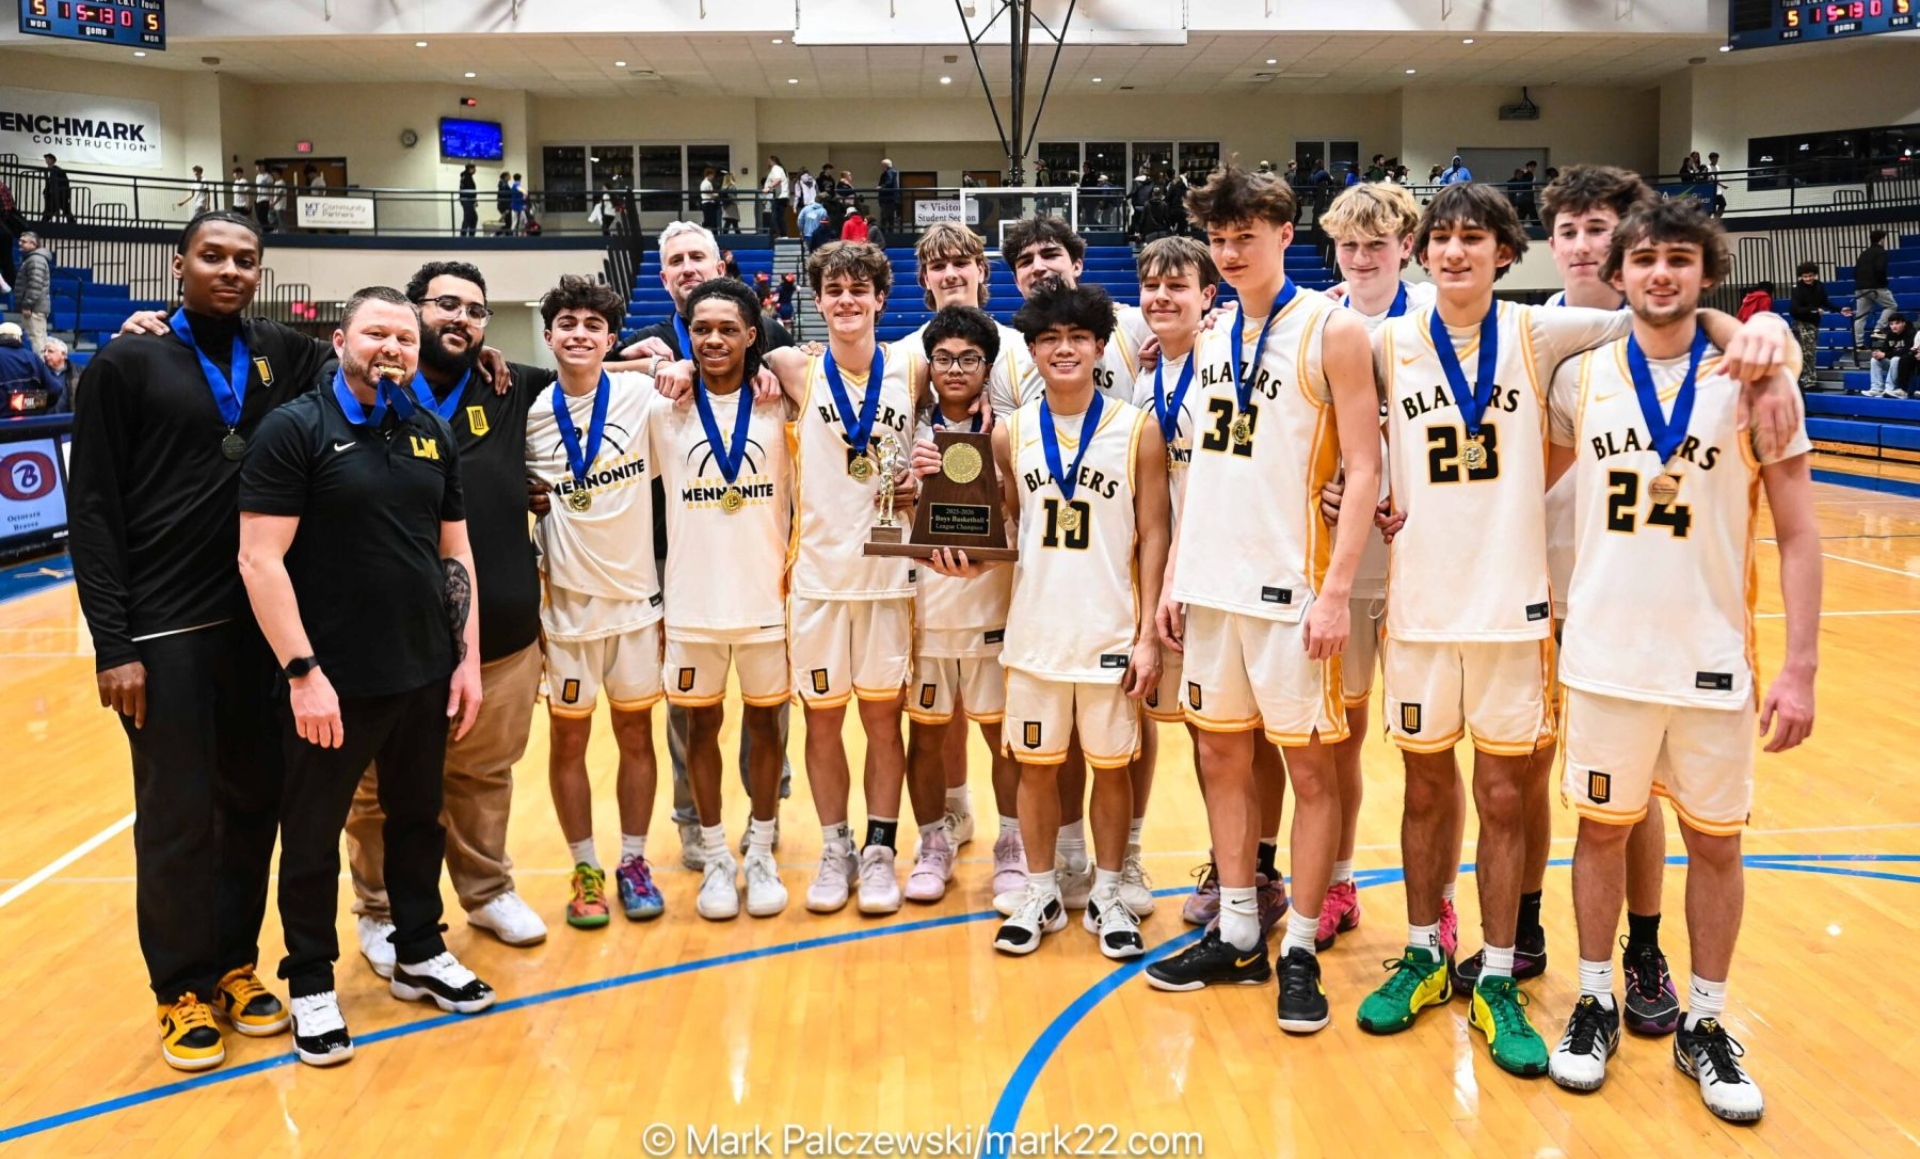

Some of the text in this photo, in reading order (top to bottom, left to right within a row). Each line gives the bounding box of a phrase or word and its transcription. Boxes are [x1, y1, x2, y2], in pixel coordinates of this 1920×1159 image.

[30, 20, 46, 28] won
[148, 14, 158, 30] 5
[1788, 10, 1798, 26] 5
[86, 26, 107, 36] game
[144, 34, 159, 43] won
[322, 204, 366, 212] Community
[918, 214, 976, 222] Student Secon
[1201, 361, 1282, 400] BLAZRS
[1402, 381, 1520, 420] BLARS
[818, 401, 906, 432] BLERS
[1202, 397, 1258, 458] 32
[410, 436, 440, 460] LM
[1427, 424, 1499, 483] 23
[1592, 428, 1721, 470] BLARS
[687, 475, 768, 488] LANCSTER
[1024, 464, 1119, 499] BLERS
[687, 499, 770, 510] BASKBALL
[1608, 471, 1692, 538] 24
[1042, 498, 1090, 550] 10
